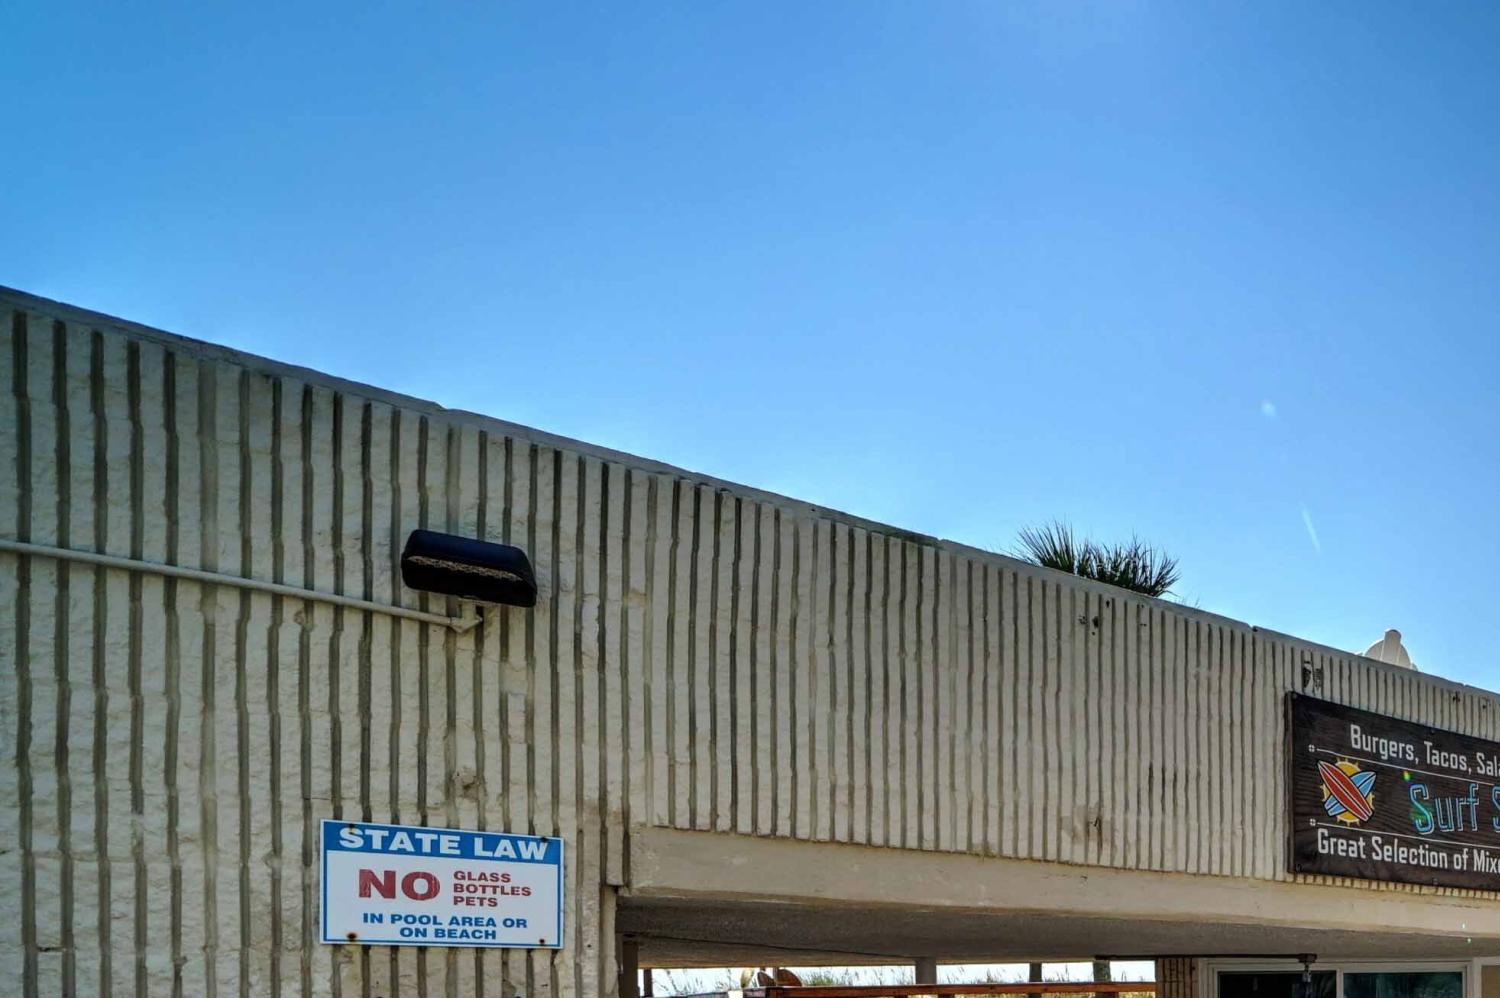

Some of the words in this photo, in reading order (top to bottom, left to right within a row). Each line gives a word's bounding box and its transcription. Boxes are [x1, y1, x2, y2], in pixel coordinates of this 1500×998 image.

[1350, 724, 1419, 764] Burgers,
[1424, 740, 1471, 774] Tacos,
[1408, 782, 1480, 836] Surf
[339, 827, 461, 856] STATE
[474, 837, 549, 861] LAW
[1317, 827, 1366, 859] Great
[1372, 837, 1448, 869] Selection
[1453, 848, 1469, 871] of
[358, 869, 441, 901] NO
[453, 870, 511, 883] GLASS
[453, 883, 532, 897] BOTTLES
[453, 896, 498, 908] PETS
[363, 913, 383, 924] IN
[390, 913, 442, 926] POOL
[448, 916, 497, 928] AREA
[502, 918, 528, 928] OR
[399, 927, 427, 938] ON
[434, 928, 497, 940] BEACH
